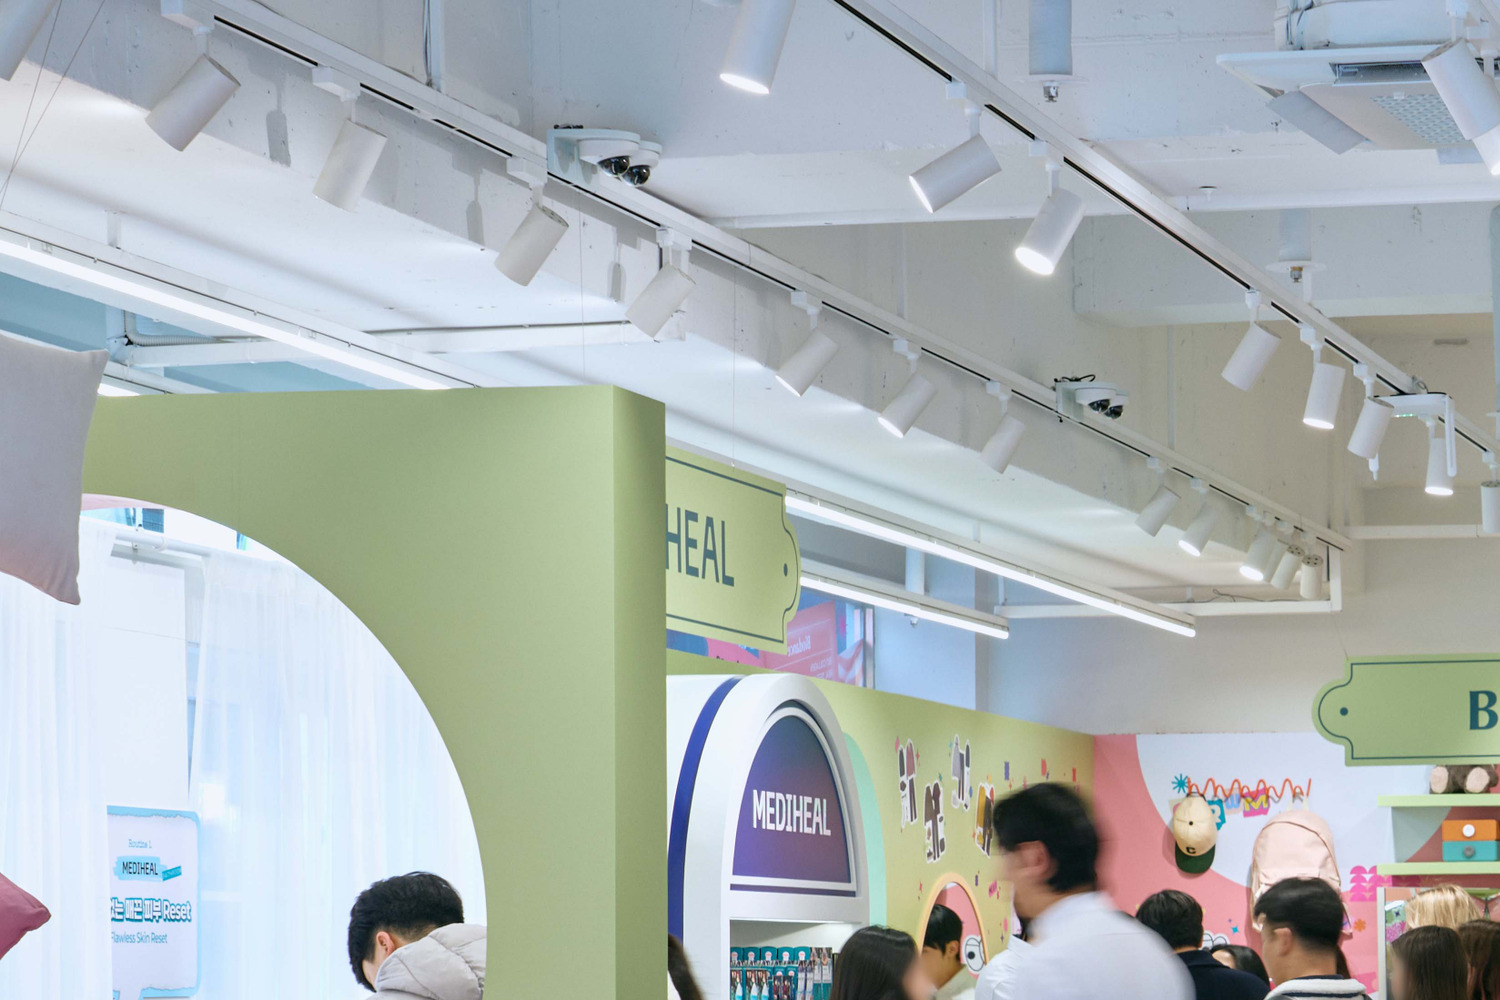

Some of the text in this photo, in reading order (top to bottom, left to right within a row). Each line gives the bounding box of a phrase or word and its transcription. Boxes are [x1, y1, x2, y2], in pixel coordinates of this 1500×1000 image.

[666, 504, 735, 587] HEAL
[753, 790, 831, 836] MEDIHEAL
[1186, 846, 1197, 855] C
[122, 861, 158, 876] MEDIHEAL
[144, 898, 162, 923] 피부
[163, 899, 191, 922] Reset
